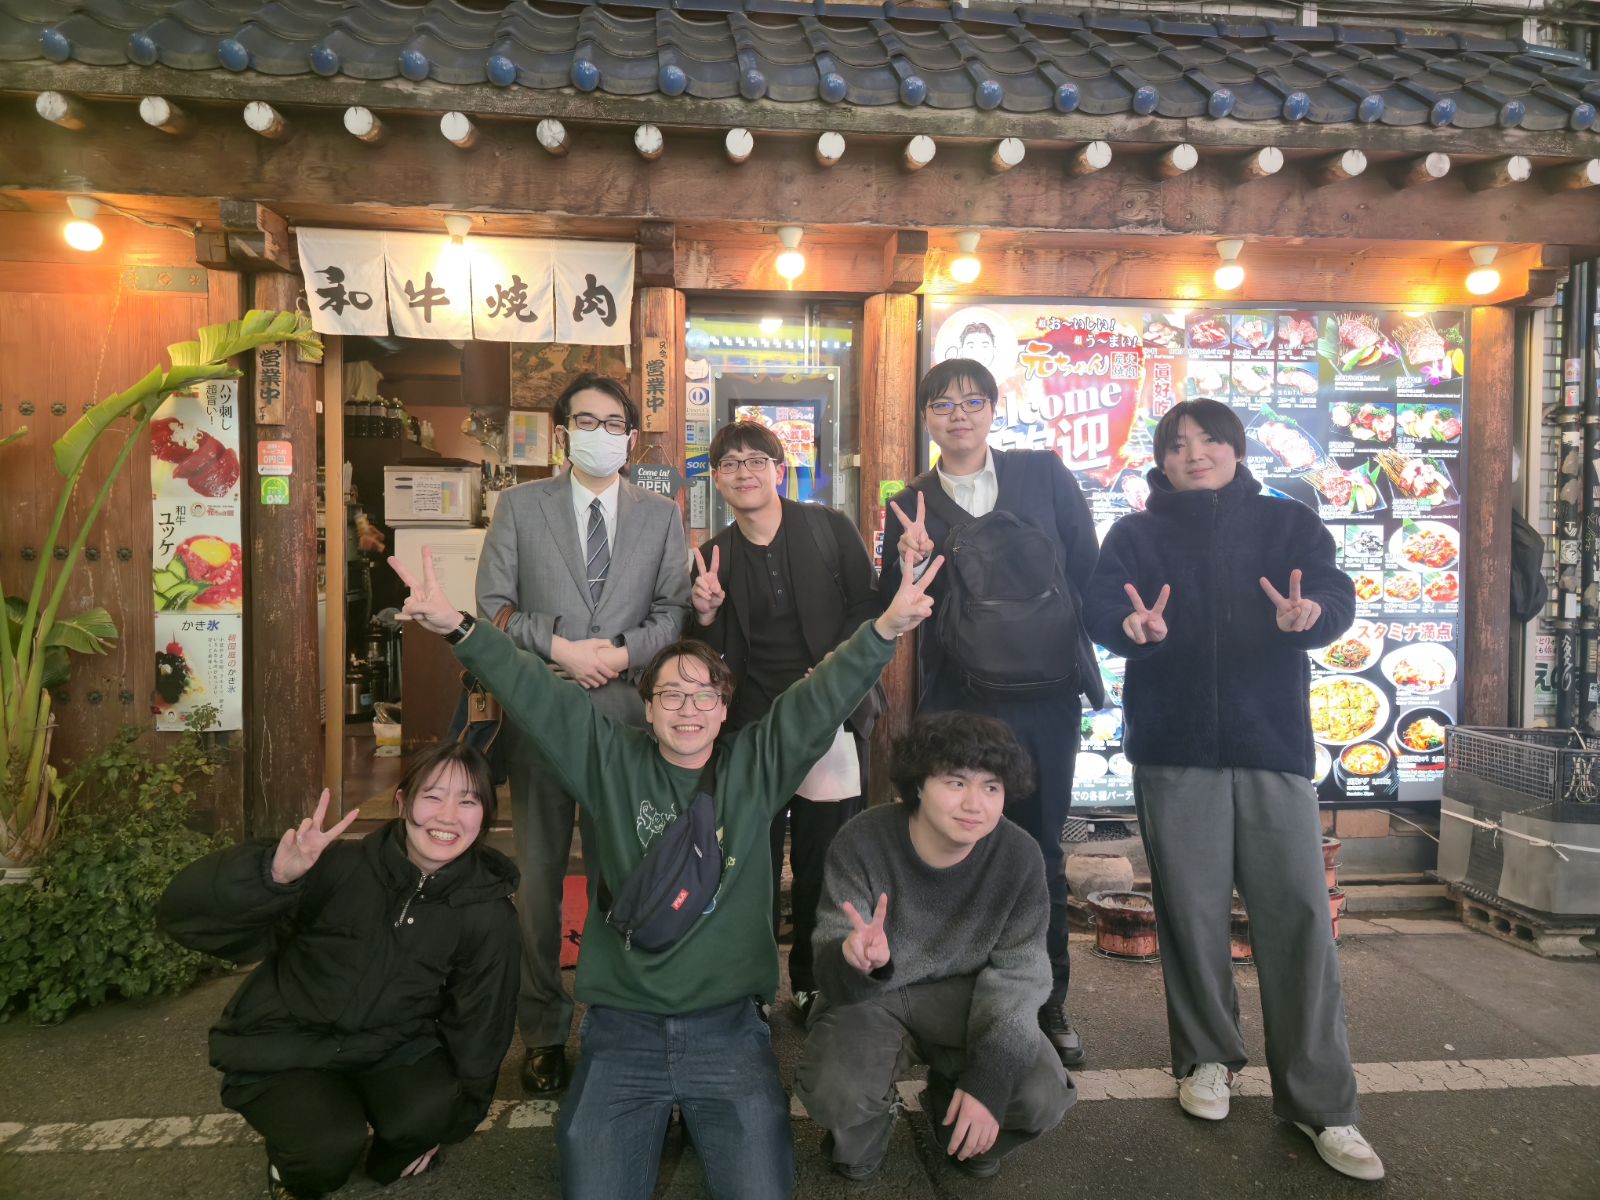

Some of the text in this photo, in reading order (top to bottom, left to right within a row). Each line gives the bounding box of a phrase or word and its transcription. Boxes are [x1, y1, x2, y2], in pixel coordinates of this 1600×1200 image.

[314, 264, 617, 327] 和牛焼肉
[260, 349, 281, 405] 営業中
[646, 359, 666, 414] 営業中
[219, 384, 232, 430] ハツ刺し
[992, 382, 1122, 431] elcome
[637, 480, 671, 494] OPEN
[638, 467, 670, 477] Come in!
[158, 512, 175, 557] ユッケ
[176, 505, 186, 526] 和牛
[181, 619, 220, 632] かき氷
[1357, 623, 1453, 641] スタミナ満点
